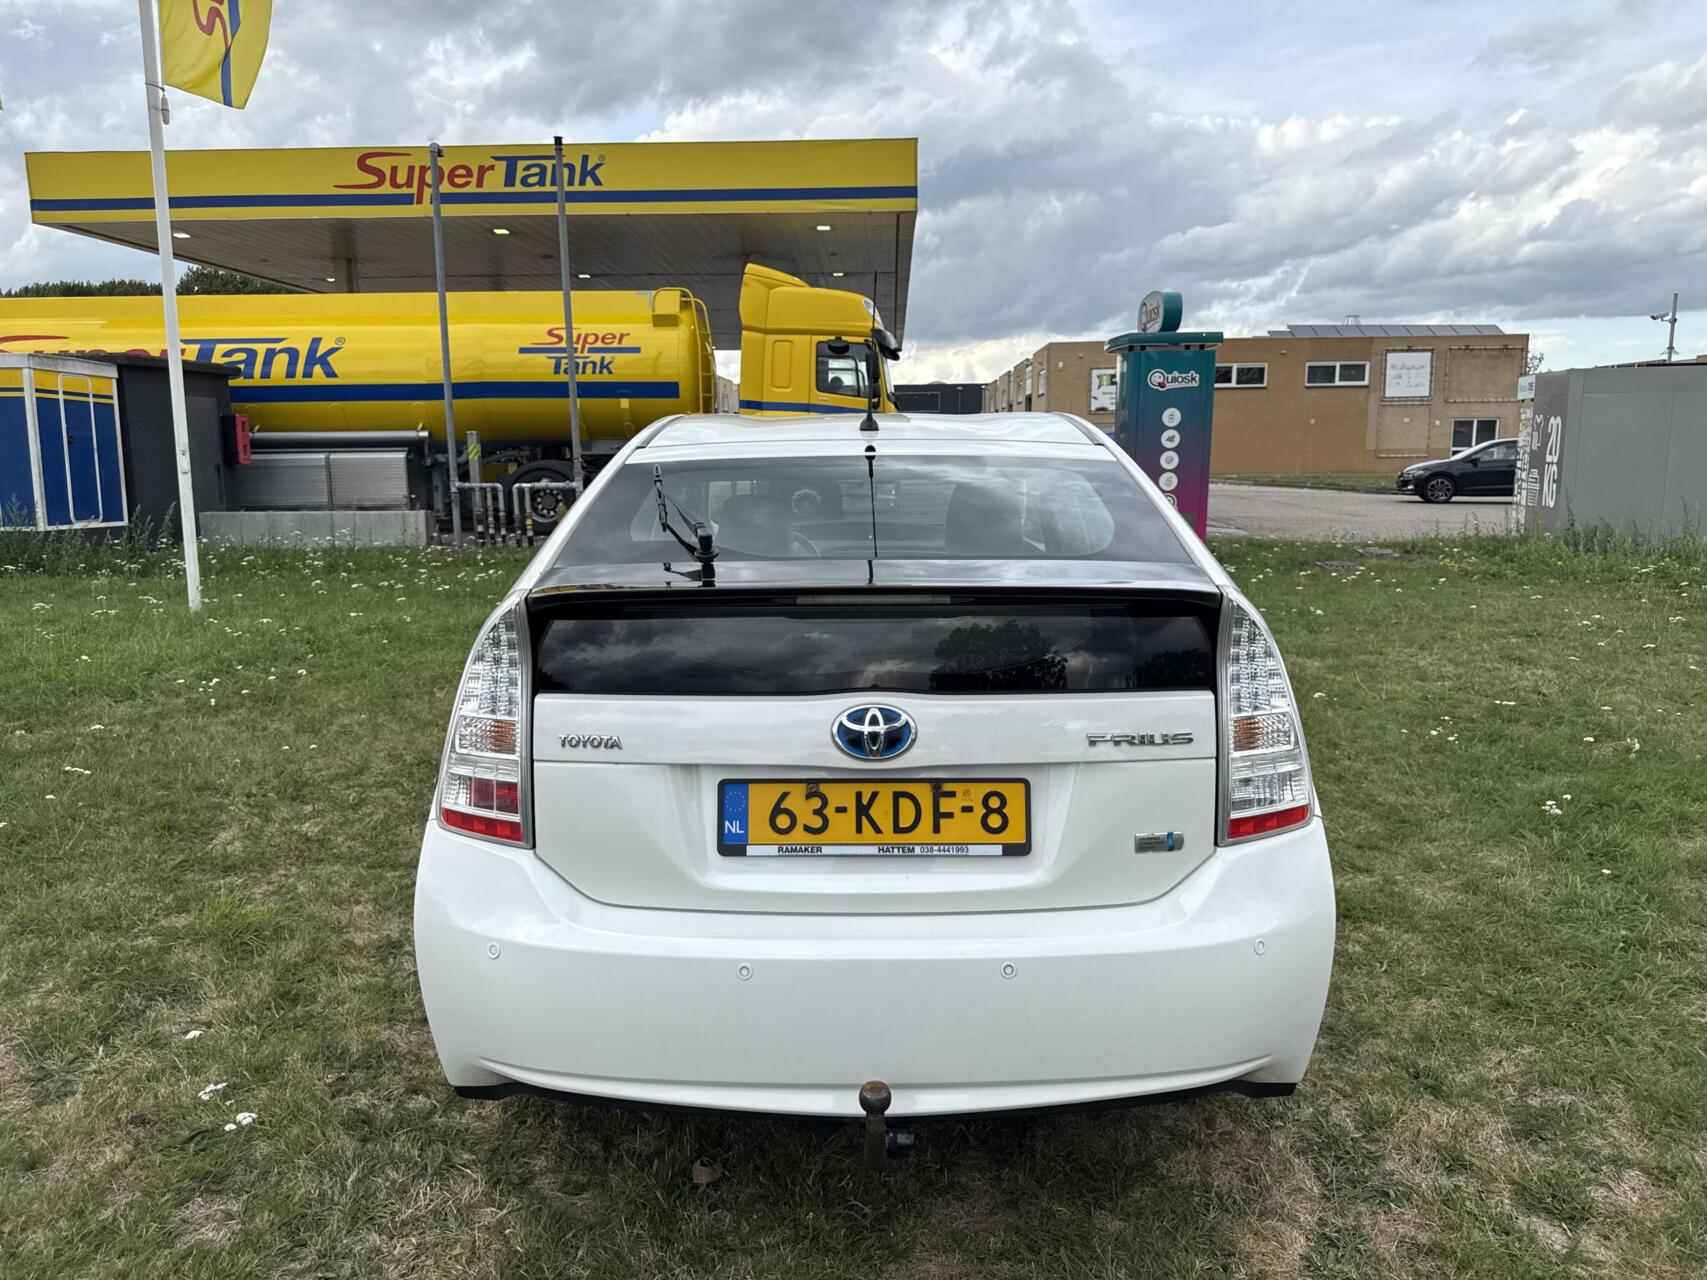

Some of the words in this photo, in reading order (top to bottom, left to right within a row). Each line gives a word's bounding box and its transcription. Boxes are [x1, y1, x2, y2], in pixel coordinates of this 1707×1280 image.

[1149, 370, 1198, 389] Quiosk
[1545, 416, 1561, 463] 20
[1542, 463, 1558, 508] KG
[558, 734, 622, 750] TOYOTA
[1087, 733, 1194, 747] PRIUS
[768, 790, 1009, 835] 63-KDF-8
[724, 820, 744, 834] NL
[778, 846, 823, 854] RAMAKER
[878, 846, 915, 854] HATTEM
[920, 846, 969, 854] 038-4441993
